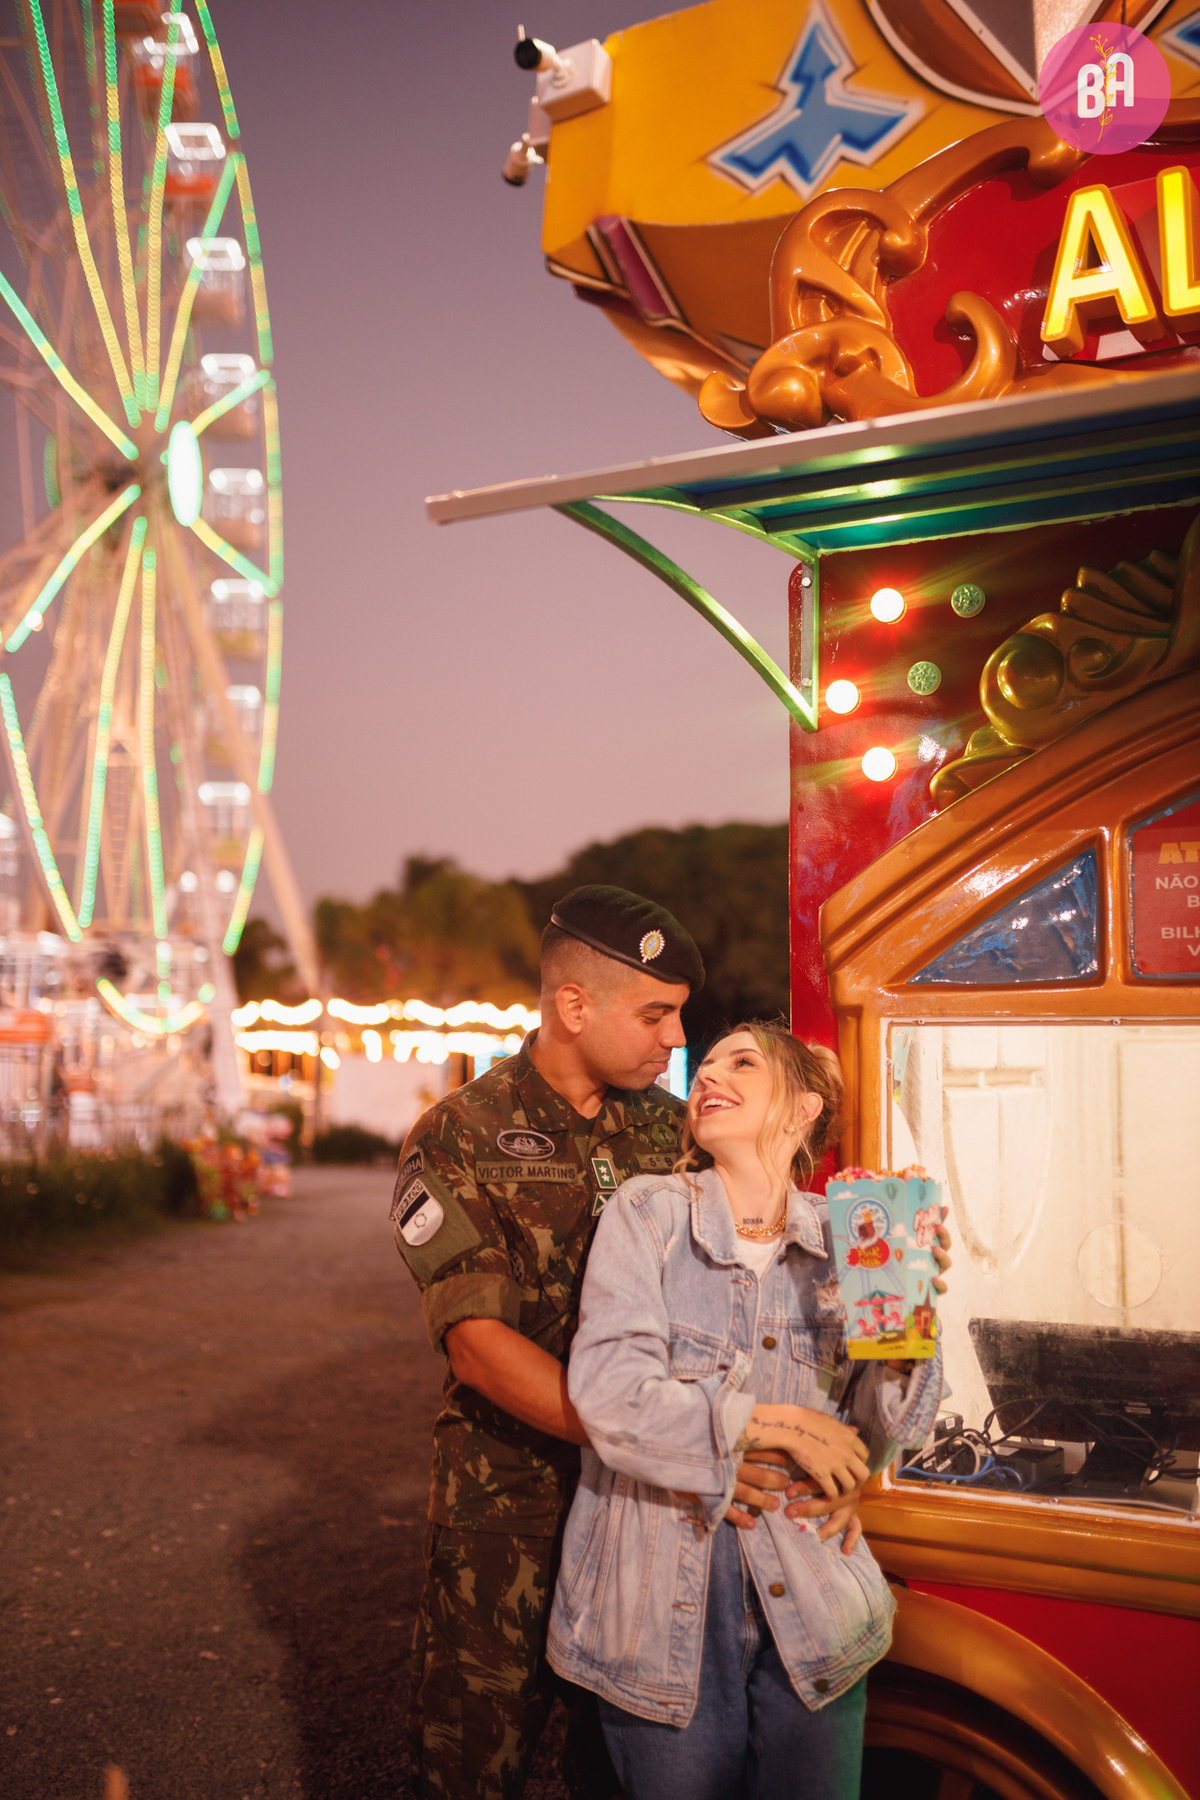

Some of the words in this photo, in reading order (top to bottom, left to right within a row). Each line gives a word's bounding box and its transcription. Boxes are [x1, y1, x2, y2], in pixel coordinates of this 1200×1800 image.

[1040, 165, 1200, 343] AL
[1158, 841, 1200, 865] AT
[1155, 873, 1199, 890] NÃO
[478, 1166, 523, 1179] VICTOR
[527, 1166, 576, 1179] MARTINS
